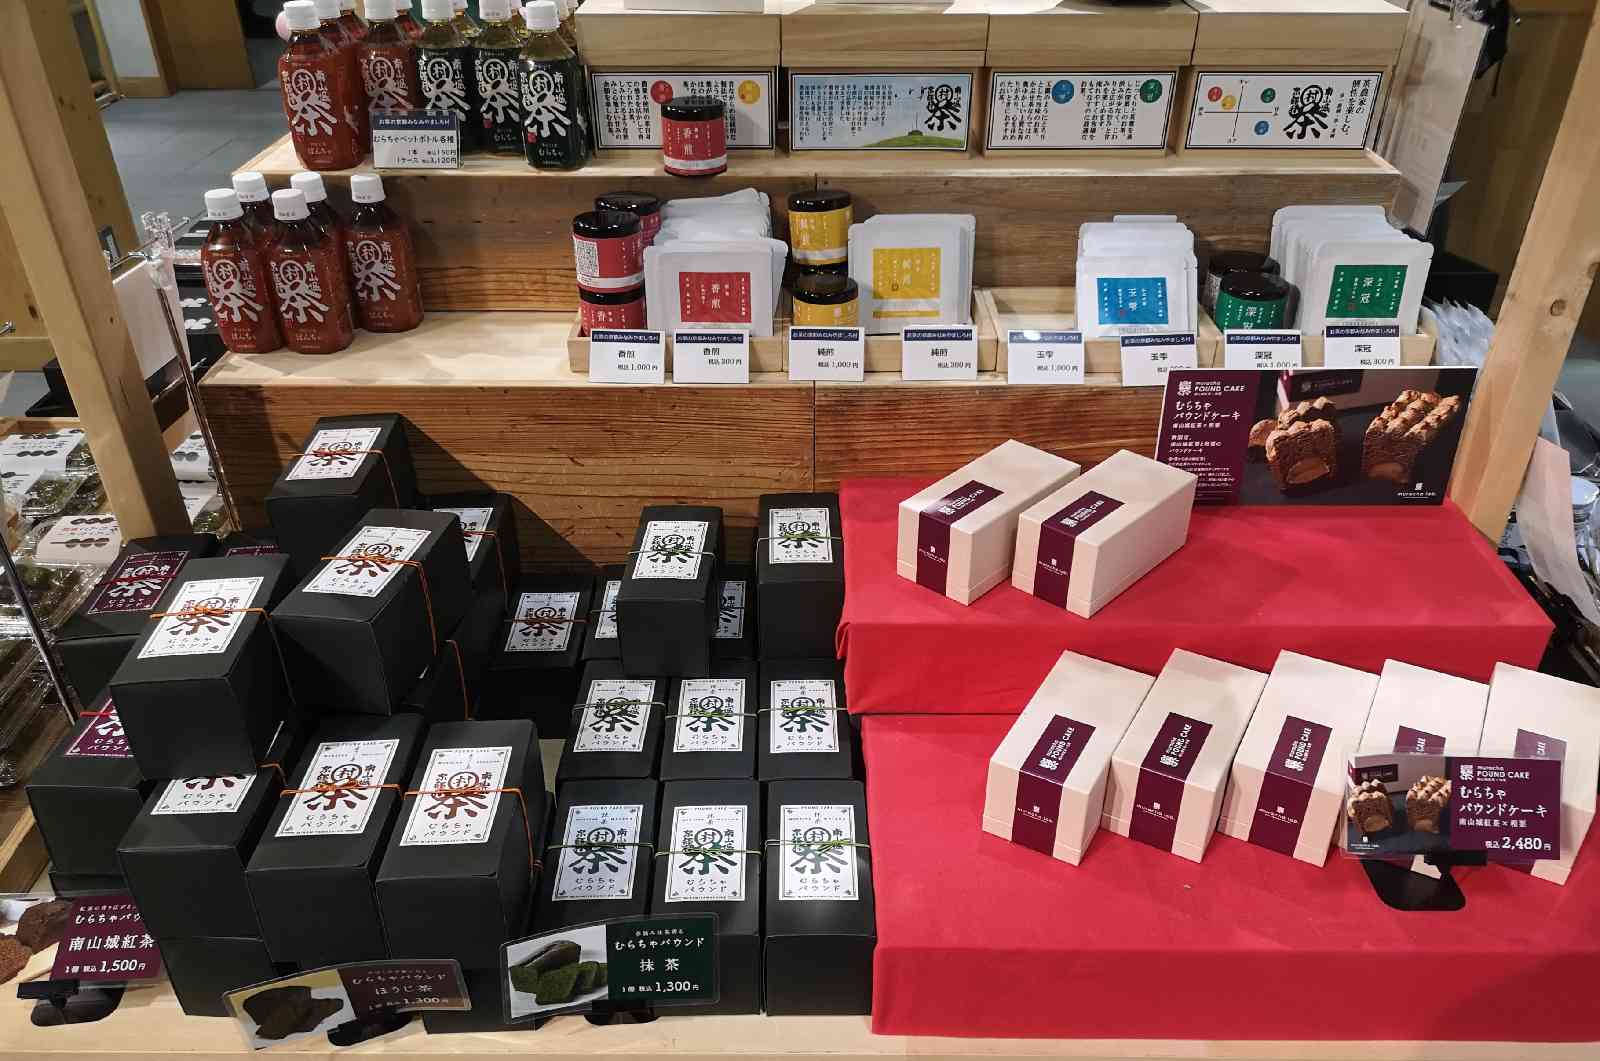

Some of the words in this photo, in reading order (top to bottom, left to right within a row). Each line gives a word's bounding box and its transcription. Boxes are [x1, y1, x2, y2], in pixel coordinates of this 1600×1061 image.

[1176, 401, 1212, 411] むらちゃ
[1173, 411, 1241, 421] パウンドケーキ
[1507, 771, 1530, 779] CAKE
[1460, 785, 1506, 800] むらちゃ
[1459, 803, 1549, 817] パウンドケーキ
[68, 935, 154, 952] 南山城紅茶
[615, 938, 704, 950] むらちゃパウンド
[639, 958, 680, 972] 抹茶
[375, 984, 433, 995] ほうじ茶
